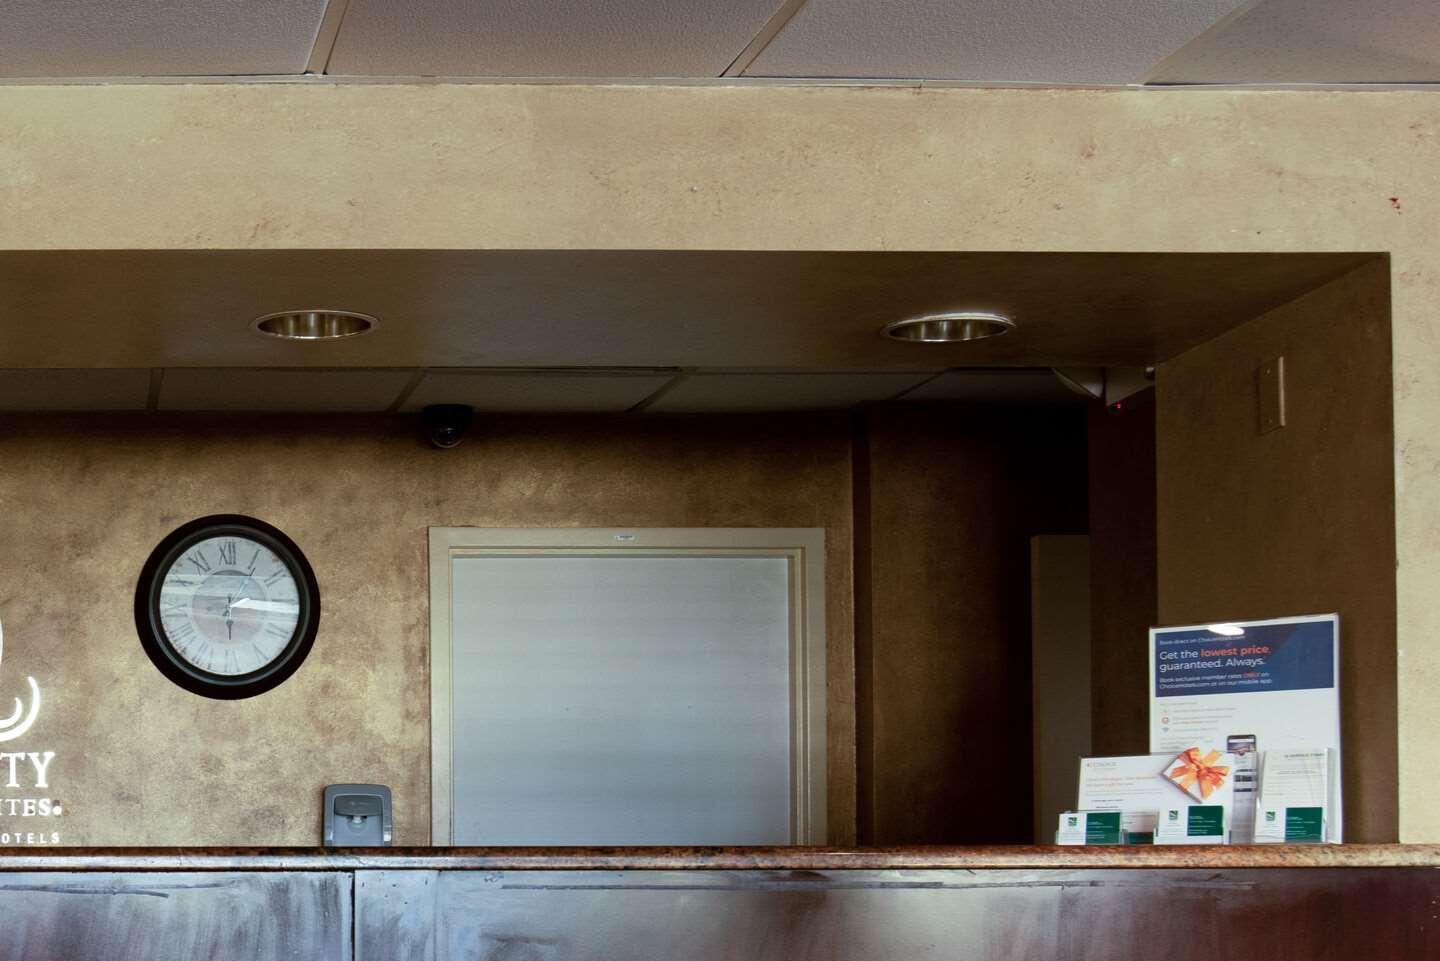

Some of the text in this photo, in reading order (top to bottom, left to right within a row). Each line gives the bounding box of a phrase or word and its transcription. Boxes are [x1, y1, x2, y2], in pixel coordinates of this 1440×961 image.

[1160, 651, 1178, 661] Get
[1180, 650, 1198, 659] the
[1200, 648, 1237, 658] lowest
[1159, 657, 1266, 672] guaranteed. Always.
